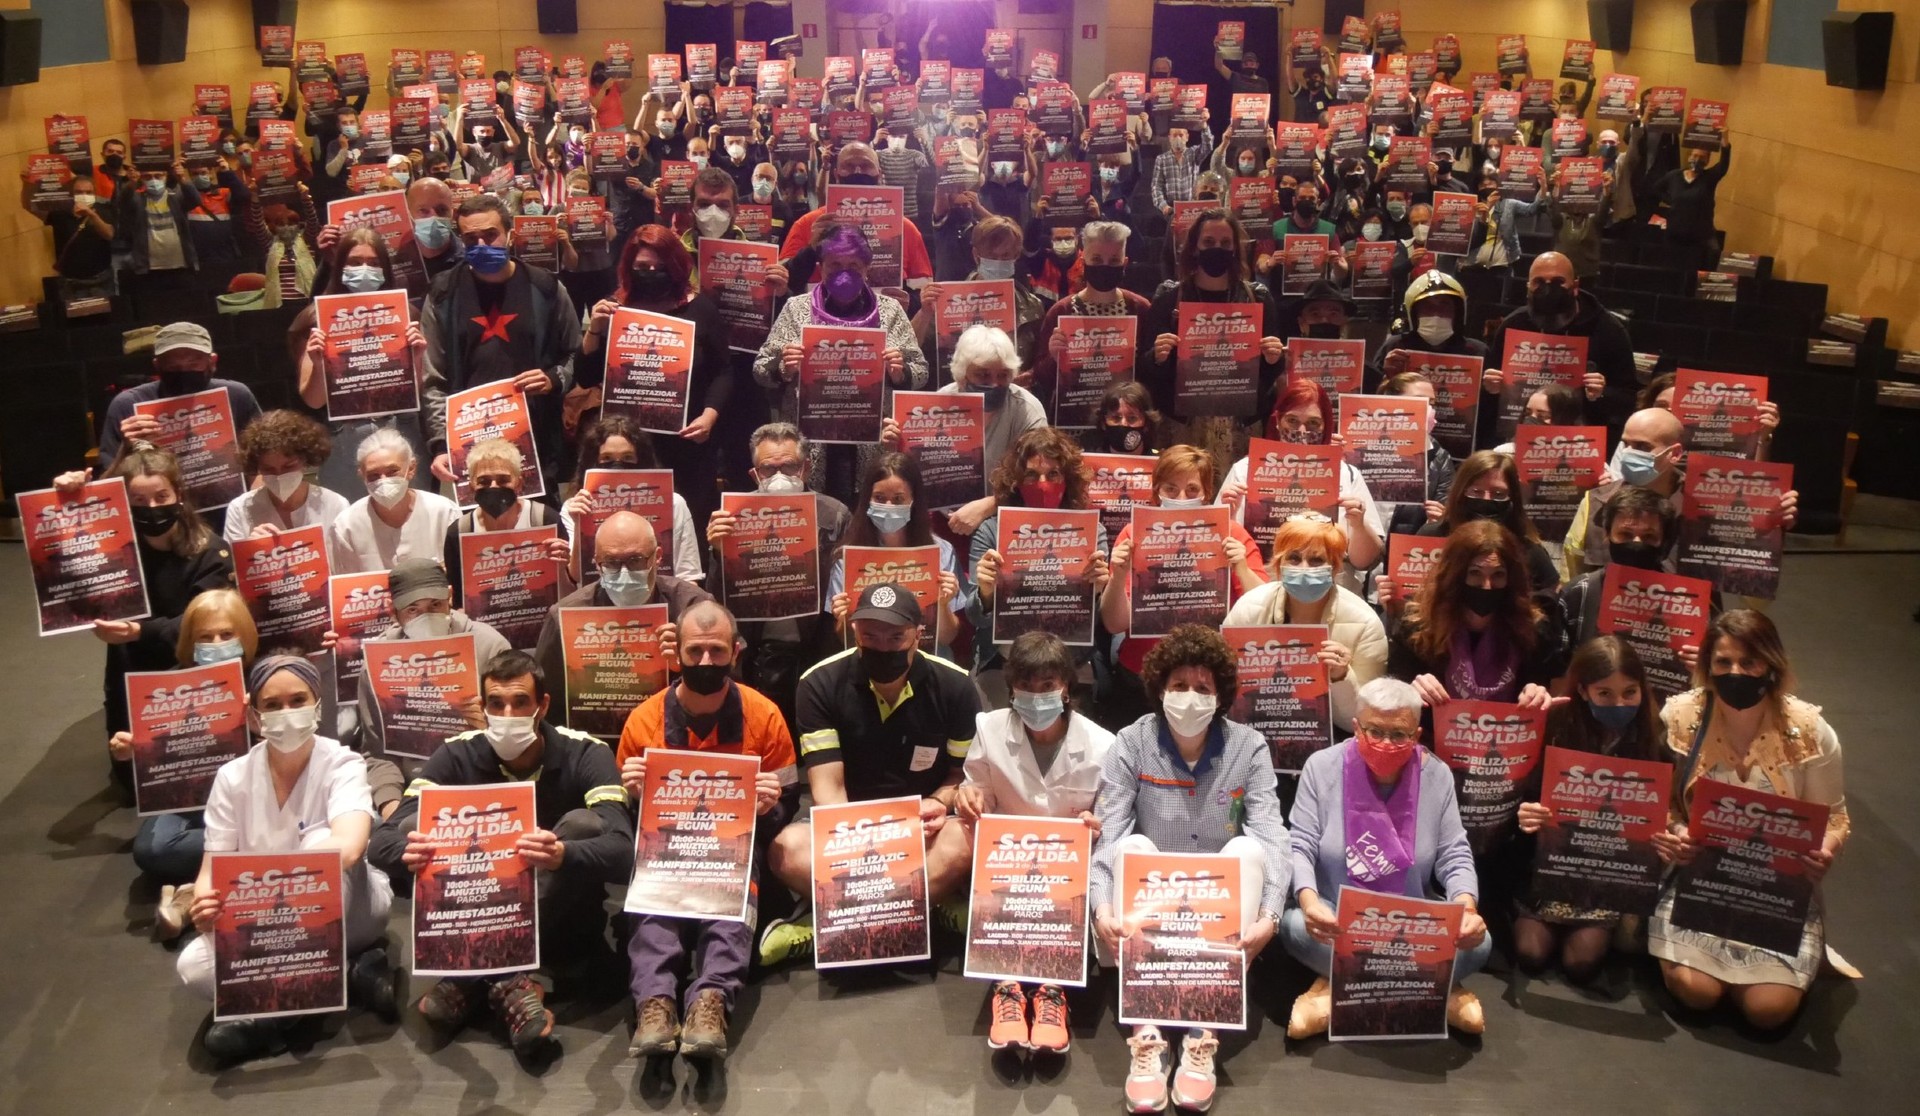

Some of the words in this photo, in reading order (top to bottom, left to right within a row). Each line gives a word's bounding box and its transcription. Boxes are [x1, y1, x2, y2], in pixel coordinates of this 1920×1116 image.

[336, 369, 404, 384] MANIFESTAZIOAK
[612, 387, 676, 397] MANIFESTAZIOAK
[47, 570, 128, 593] MANIFESTAZIOAK
[1006, 595, 1081, 603] MANIFESTAZIOAK
[1141, 590, 1216, 600] MANIFESTAZIOAK
[475, 605, 547, 622] MANIFESTAZIOAK
[148, 752, 237, 773] MANIFESTAZIOAK
[666, 769, 734, 786] S.O.S.
[436, 802, 507, 827] S.O.S.
[675, 821, 715, 830] EGUNA
[835, 814, 898, 837] S.O.S.
[999, 833, 1065, 849] S.O.S.
[450, 861, 493, 875] EGUNA
[647, 861, 735, 869] MANIFESTAZIOAK
[850, 863, 888, 876] EGUNA
[1548, 854, 1646, 873] MANIFESTAZIOAK
[239, 867, 312, 887] S.O.S.
[1146, 870, 1215, 887] S.O.S.
[1009, 884, 1050, 892] EGUNA
[424, 904, 520, 920] MANIFESTAZIOAK
[827, 899, 914, 918] MANIFESTAZIOAK
[256, 914, 301, 926] EGUNA
[982, 923, 1071, 931] MANIFESTAZIOAK
[1161, 922, 1203, 930] EGUNA
[229, 950, 329, 968] MANIFESTAZIOAK
[1135, 962, 1228, 970] MANIFESTAZIOAK
[1344, 982, 1435, 991] MANIFESTAZIOAK
